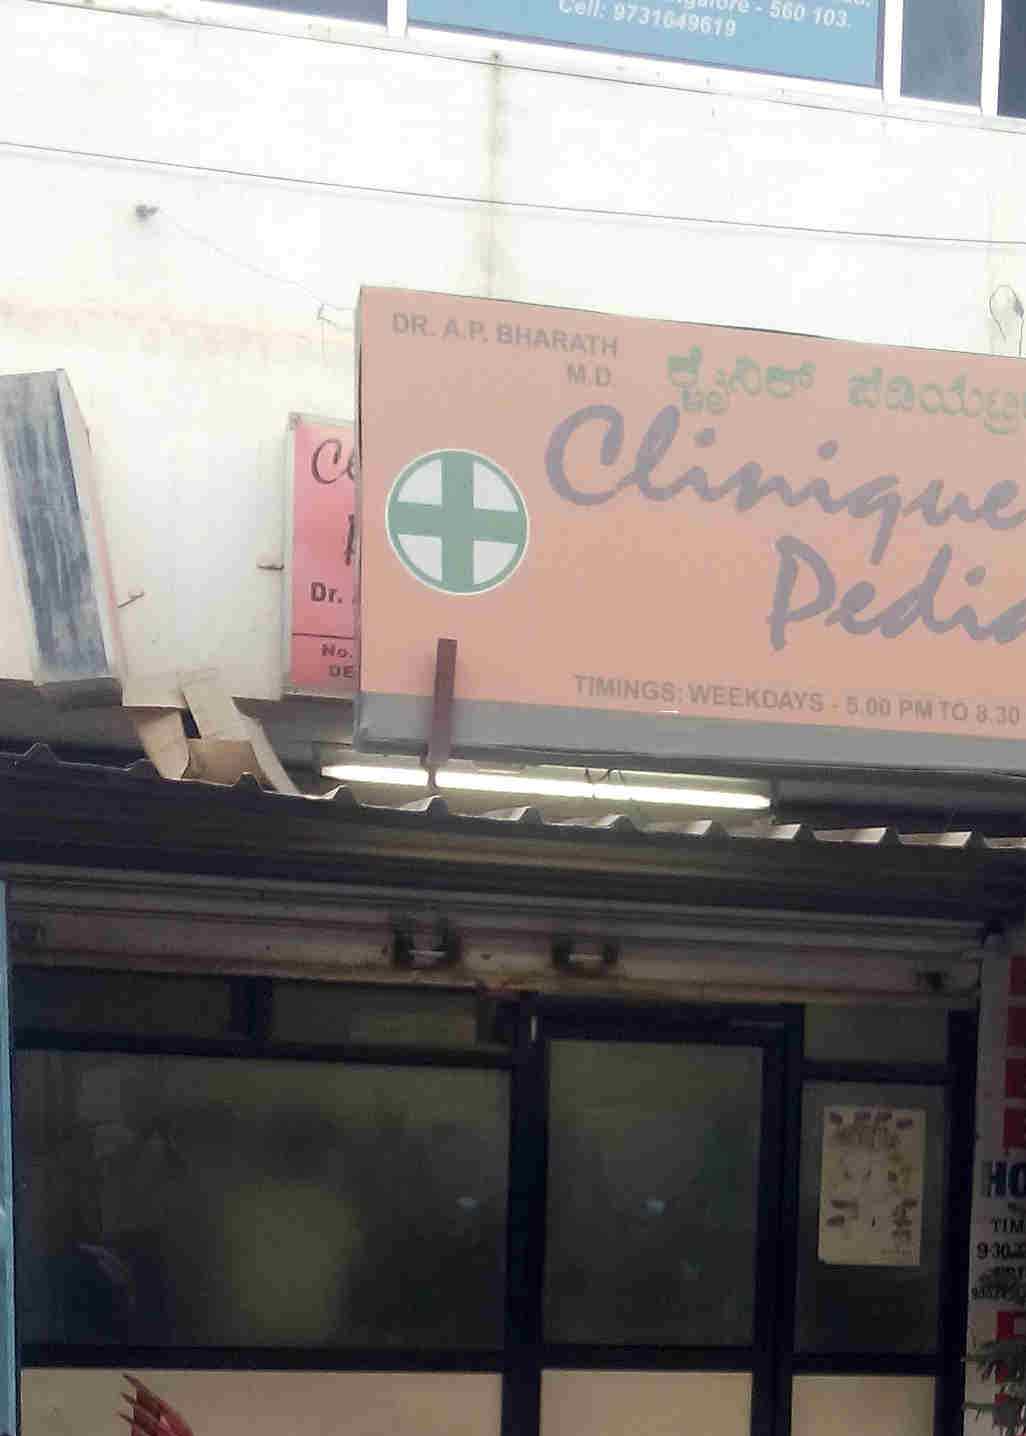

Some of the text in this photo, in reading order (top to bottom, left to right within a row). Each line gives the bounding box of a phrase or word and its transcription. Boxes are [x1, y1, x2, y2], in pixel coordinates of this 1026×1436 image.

[391, 312, 618, 359] DR. A.P. BHARATH
[574, 674, 684, 703] TIMINGS:
[687, 681, 825, 713] WEEKDAYS
[846, 695, 891, 717] 5.00
[899, 700, 933, 722] PM
[938, 701, 968, 722] TO
[975, 702, 1021, 726] 8.30
